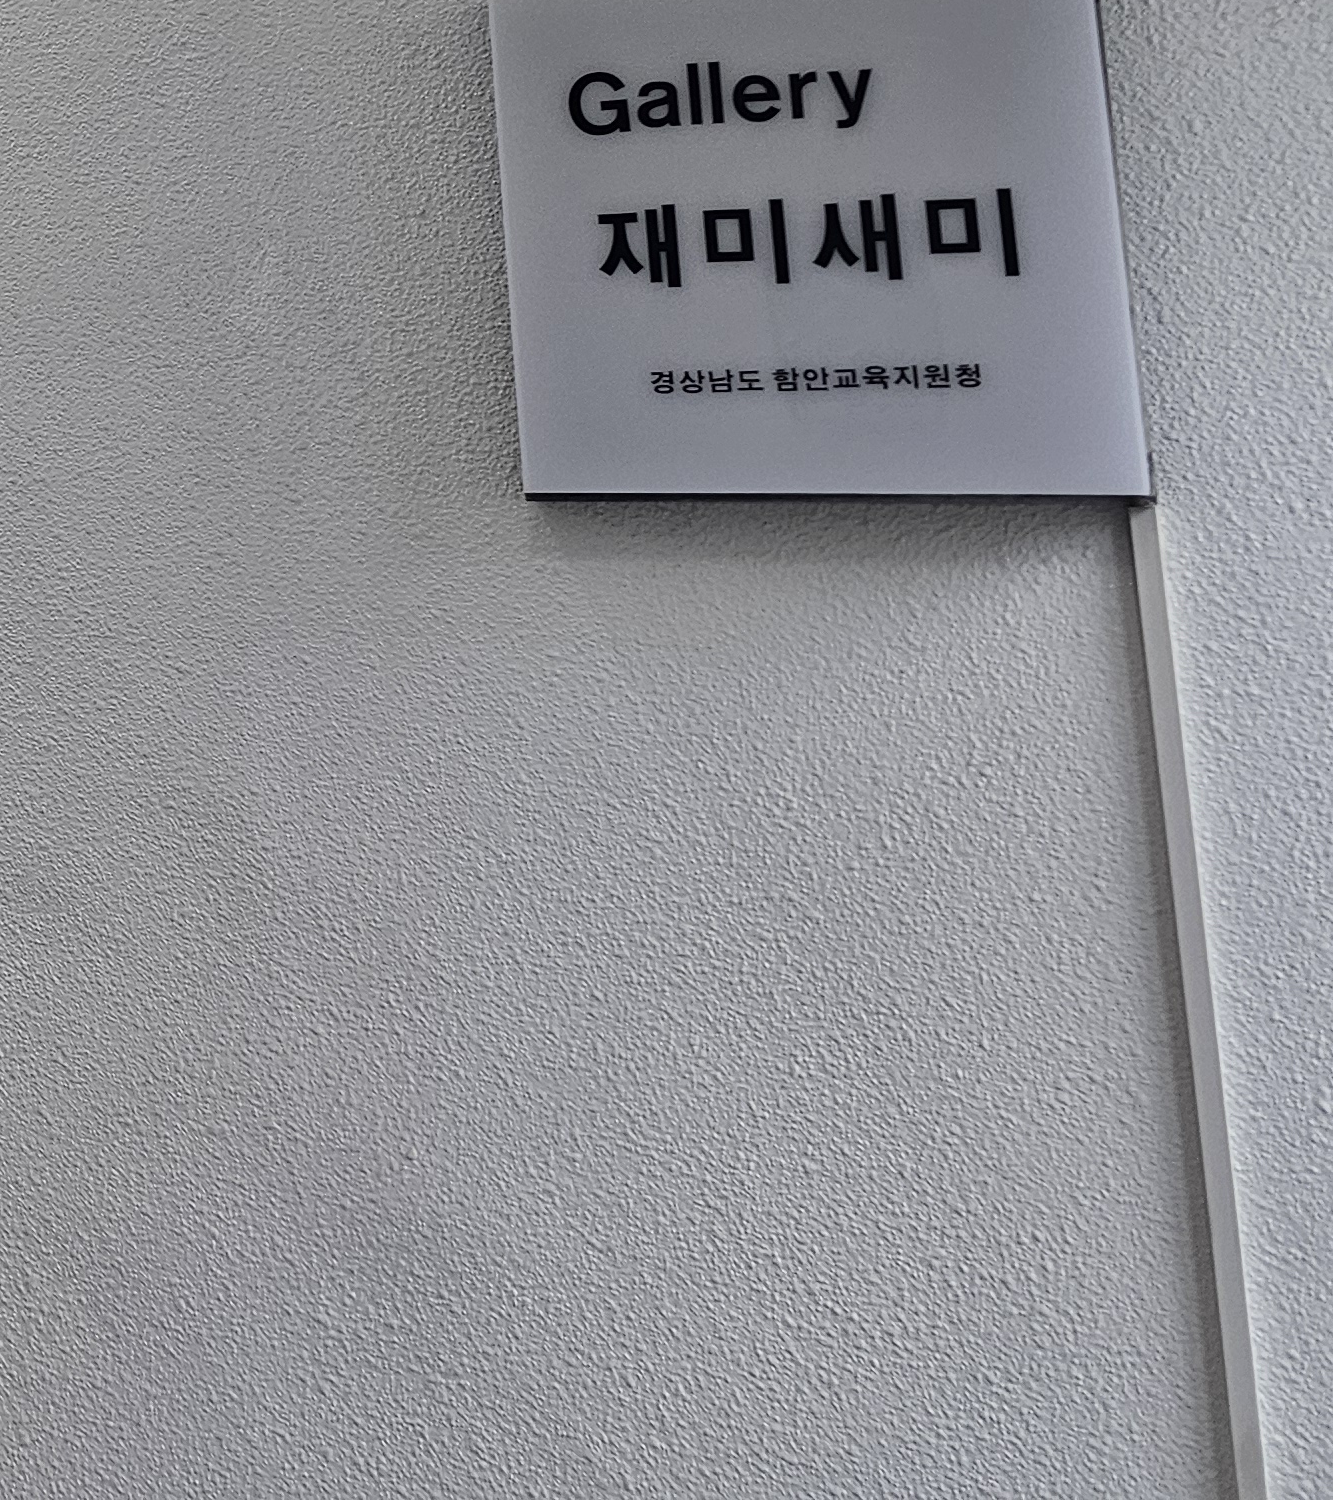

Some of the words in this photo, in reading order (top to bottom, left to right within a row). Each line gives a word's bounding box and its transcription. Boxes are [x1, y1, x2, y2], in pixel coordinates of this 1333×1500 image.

[568, 61, 873, 136] Gallery
[597, 187, 1021, 288] 재미새미
[650, 368, 765, 395] 경상남도
[771, 363, 983, 392] 함안교육지원청
